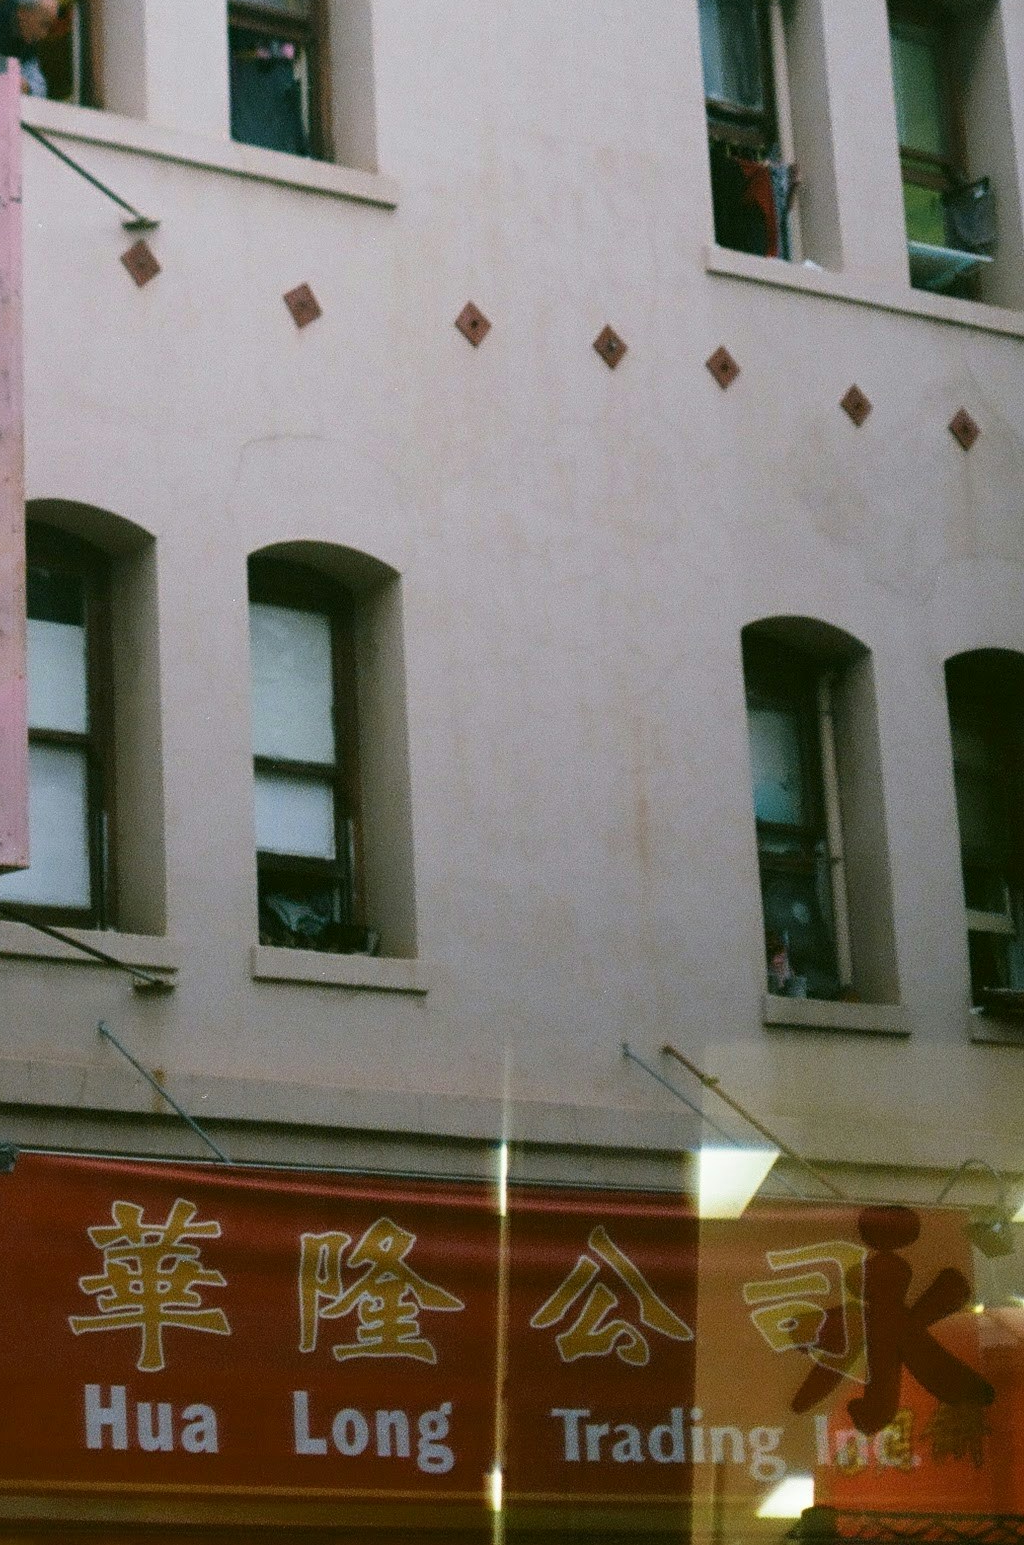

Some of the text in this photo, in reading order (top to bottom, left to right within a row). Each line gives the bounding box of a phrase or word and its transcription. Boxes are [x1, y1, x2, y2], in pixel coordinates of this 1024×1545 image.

[68, 1197, 871, 1384] 華隆公司
[84, 1382, 219, 1454] Hua
[292, 1389, 455, 1475] Long
[551, 1407, 782, 1483] Trading
